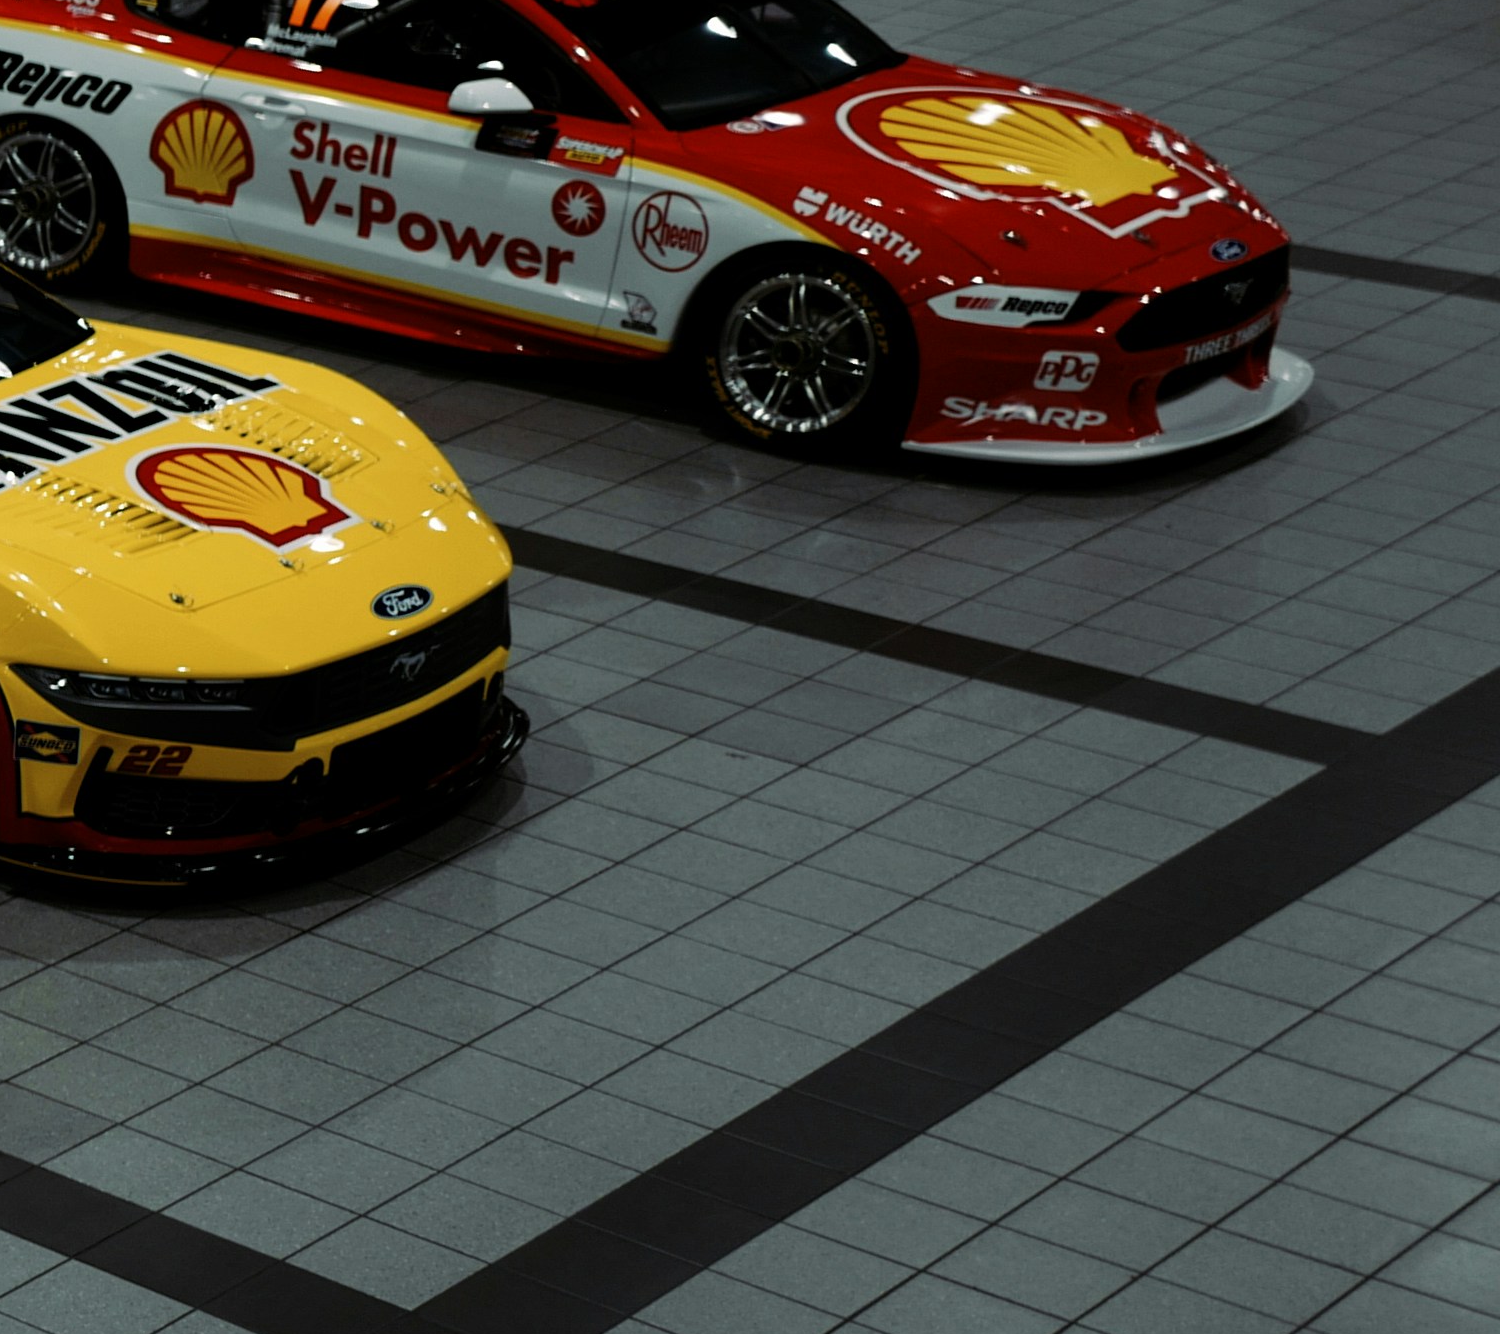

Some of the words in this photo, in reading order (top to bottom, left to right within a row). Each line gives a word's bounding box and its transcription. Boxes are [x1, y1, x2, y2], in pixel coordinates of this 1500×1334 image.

[291, 122, 396, 178] Shell
[290, 171, 575, 285] V-Power
[641, 190, 703, 258] Rheem
[824, 201, 923, 266] WÜRTH
[1003, 296, 1069, 318] Repco
[1038, 354, 1097, 387] PPG
[940, 396, 1108, 432] SHARP
[381, 591, 426, 613] Ford
[17, 731, 78, 753] SUNOCO
[117, 745, 193, 777] 22
